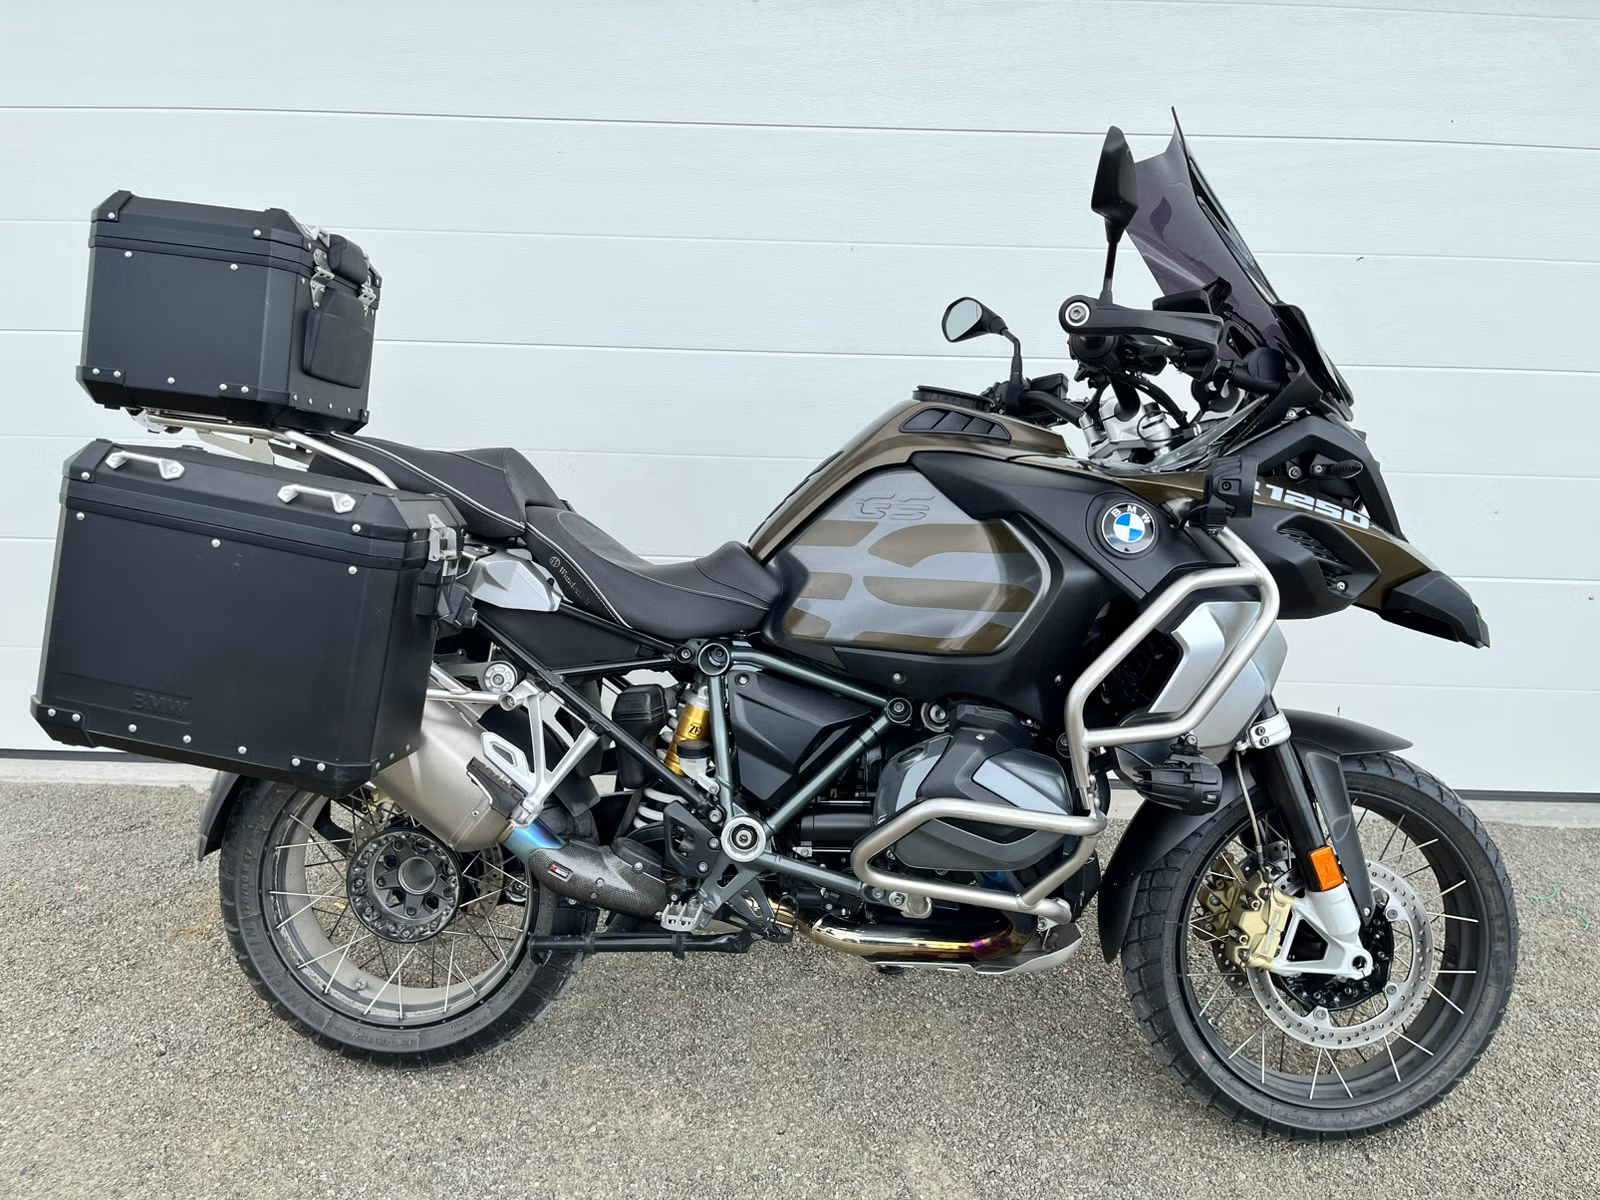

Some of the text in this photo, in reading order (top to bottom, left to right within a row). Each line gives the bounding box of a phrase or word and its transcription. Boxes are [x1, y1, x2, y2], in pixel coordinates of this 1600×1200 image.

[852, 494, 936, 521] GS
[1110, 504, 1151, 524] BMW
[1265, 483, 1370, 530] 1250
[131, 691, 189, 718] BMW
